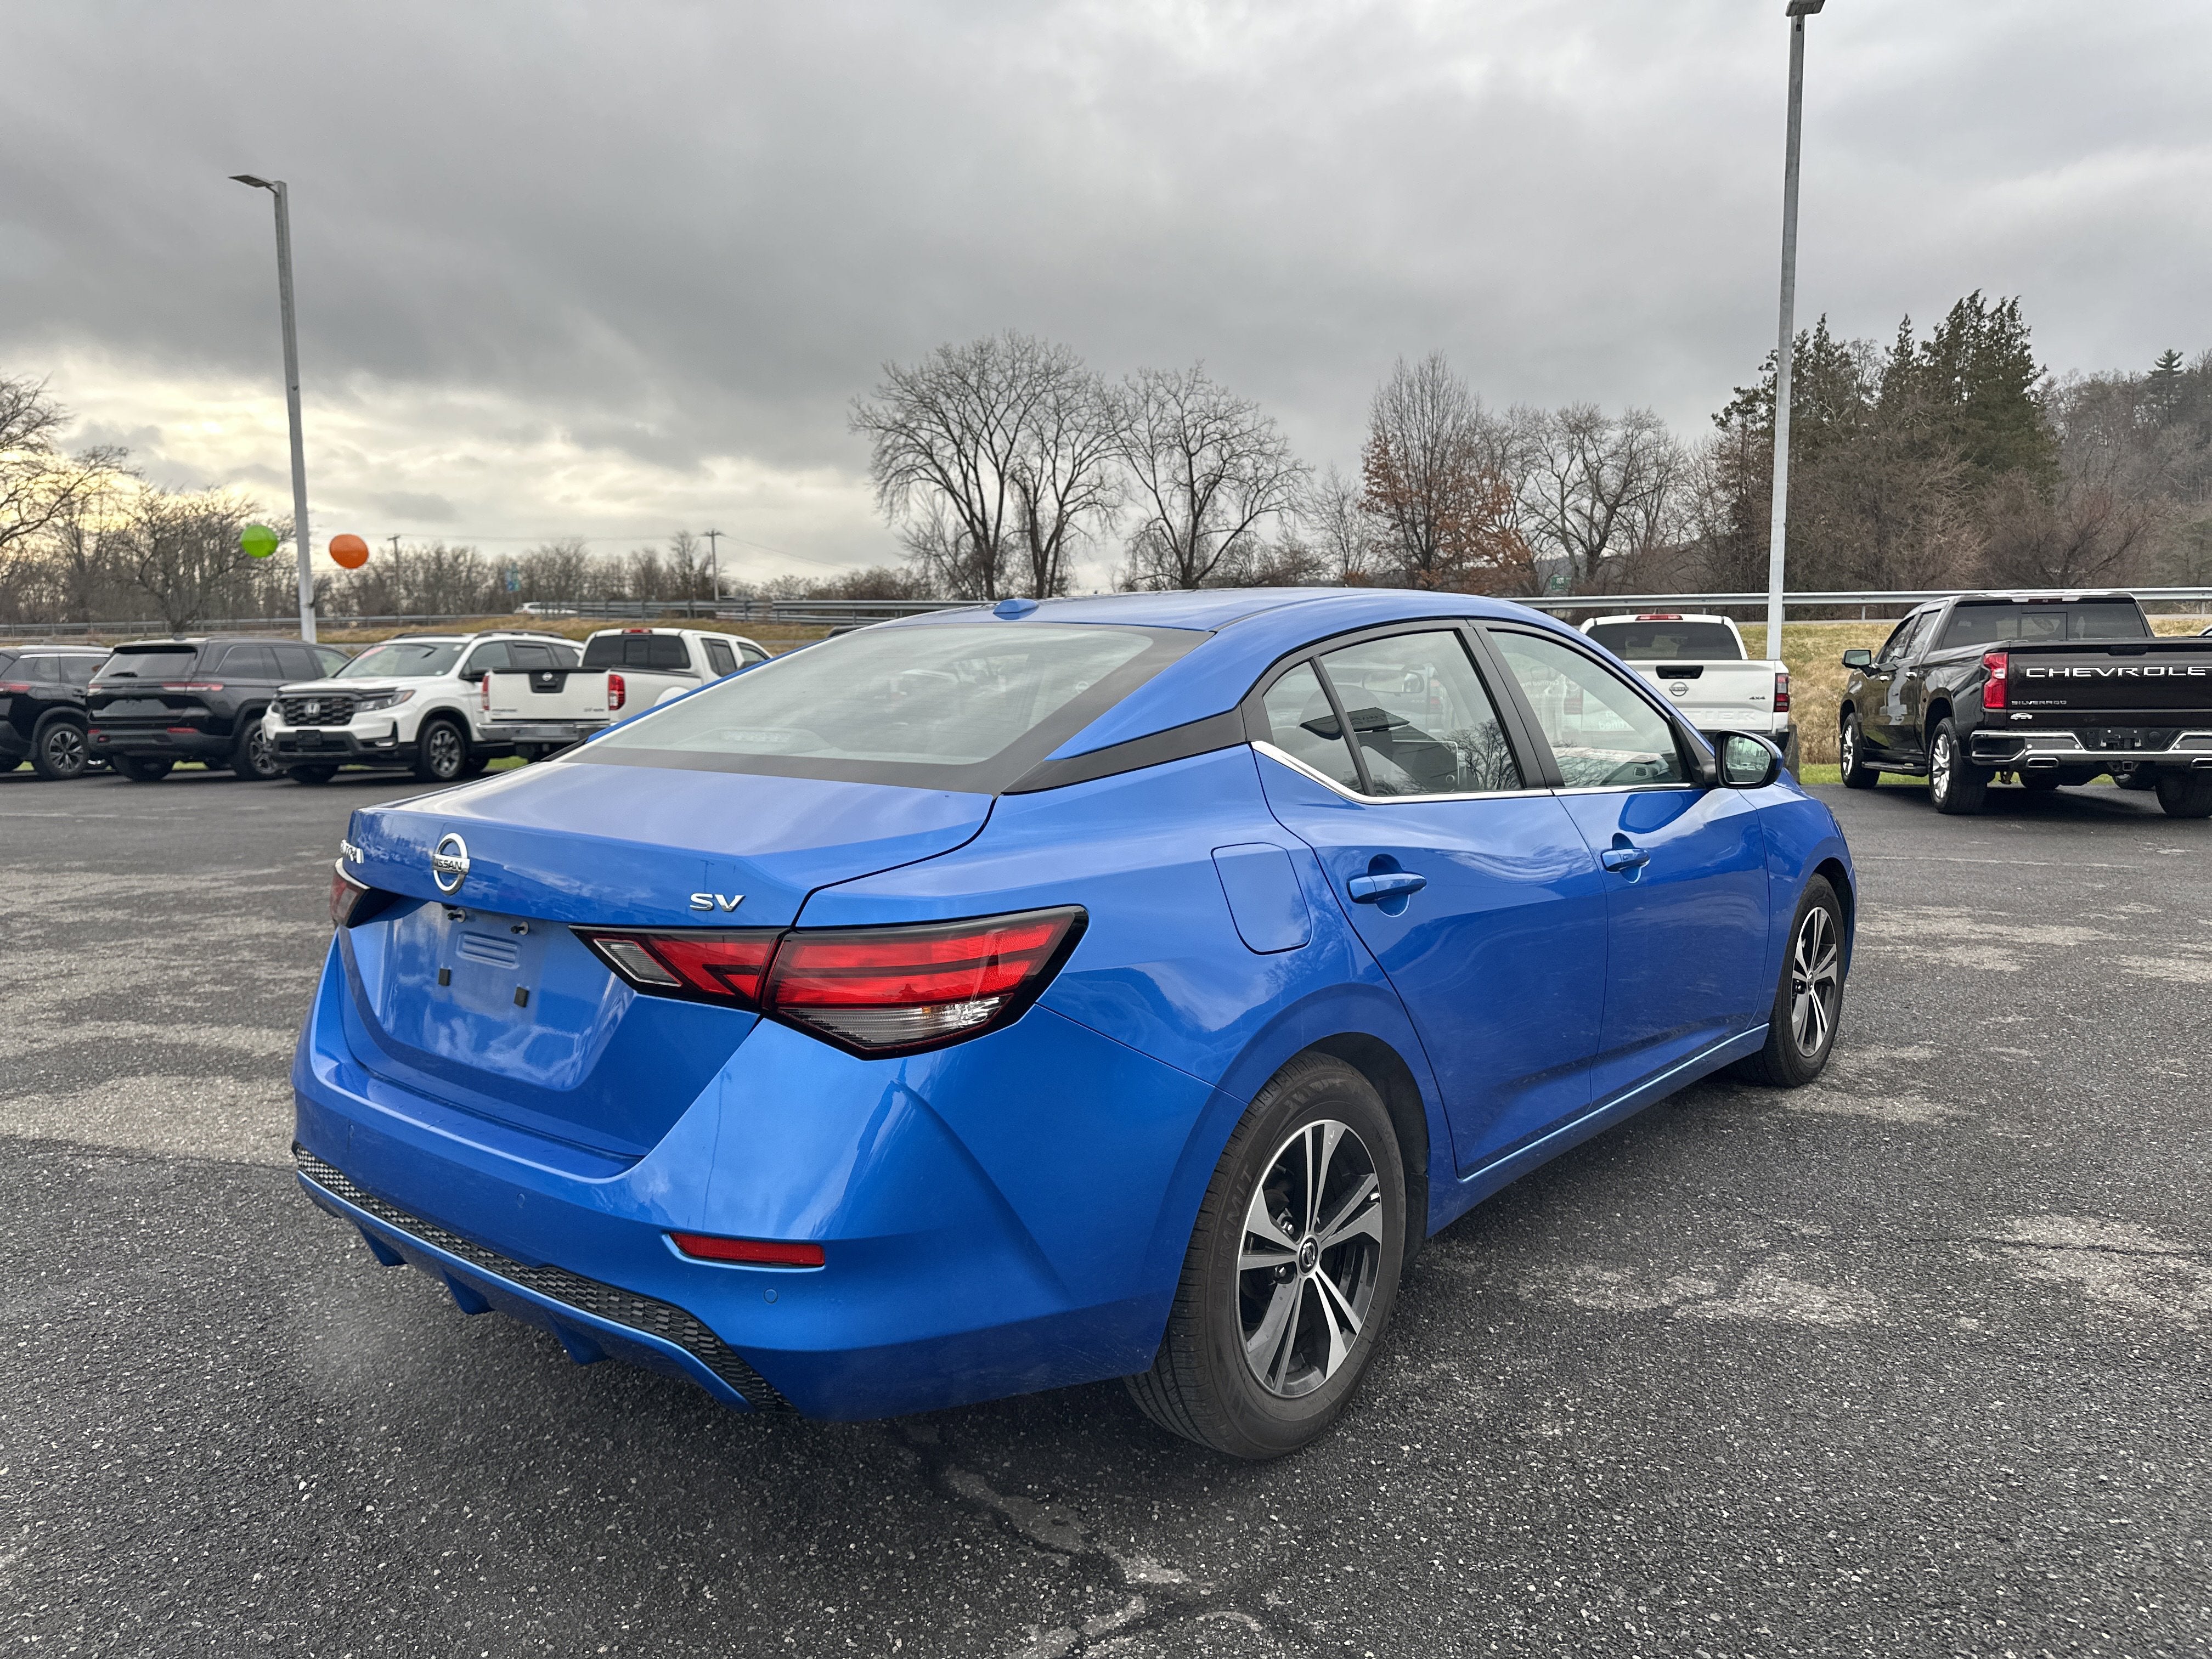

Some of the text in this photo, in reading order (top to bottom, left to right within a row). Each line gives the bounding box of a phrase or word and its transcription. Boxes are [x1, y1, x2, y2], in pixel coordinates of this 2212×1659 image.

[1683, 711, 1756, 721] TIER
[690, 893, 746, 912] SV
[1214, 1161, 1252, 1310] SUMMIT
